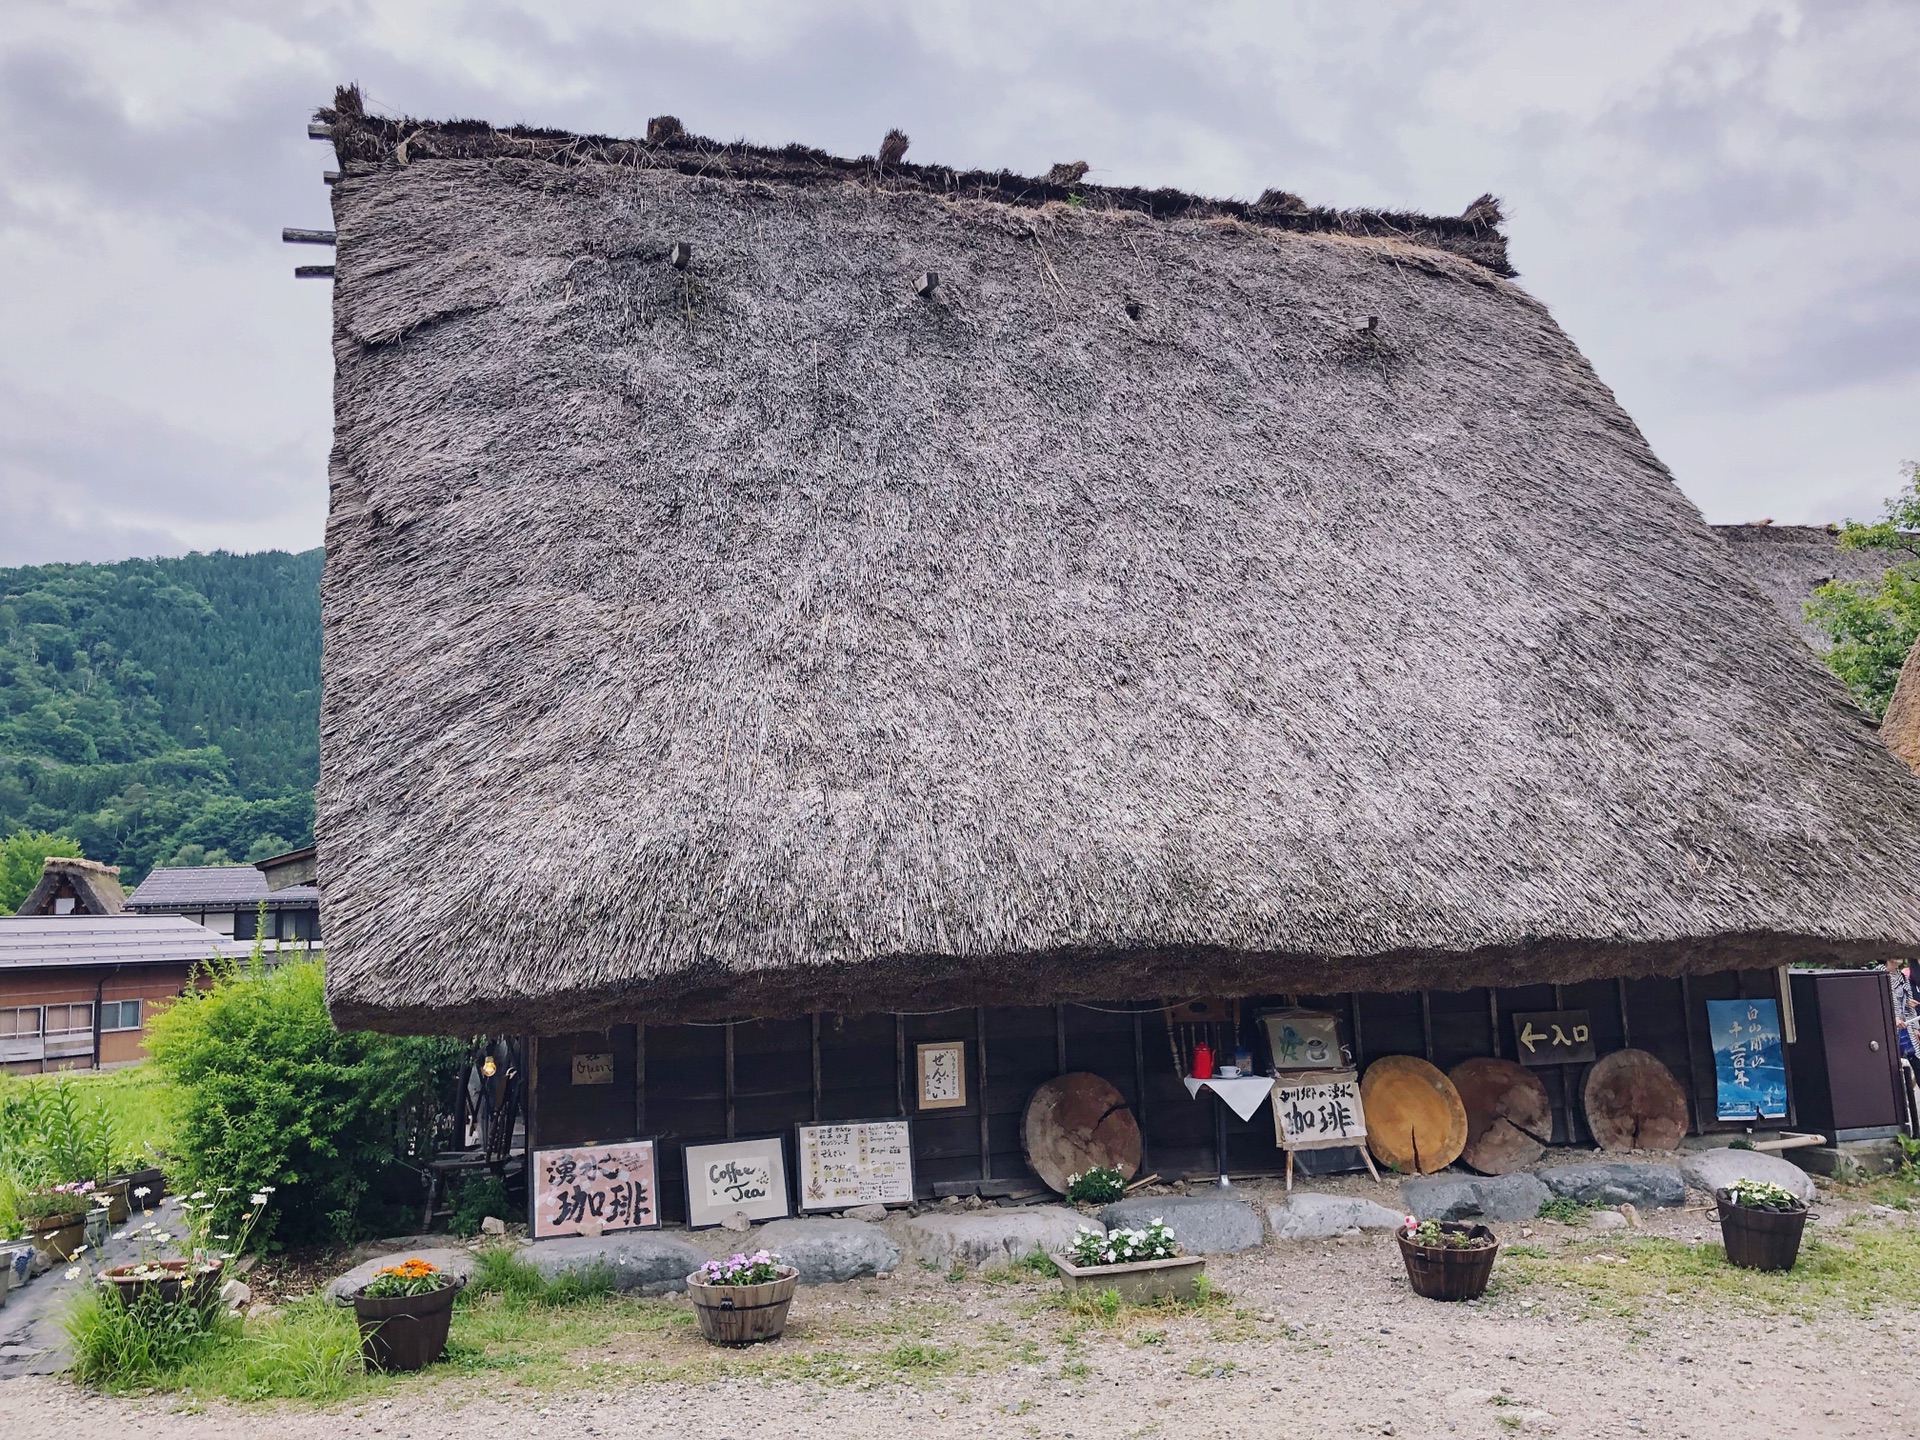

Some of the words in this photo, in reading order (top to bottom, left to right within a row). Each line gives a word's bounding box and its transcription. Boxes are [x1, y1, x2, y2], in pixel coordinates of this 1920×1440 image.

[1551, 1024, 1589, 1046] 入口
[1746, 1005, 1765, 1068] 白山開山
[932, 1051, 949, 1099] ぜんざい
[1284, 1100, 1355, 1137] 珈琲
[546, 1153, 619, 1187] 湧水
[709, 1161, 756, 1184] Coffee
[553, 1181, 651, 1226] 珈琲
[724, 1181, 766, 1202] Tea
